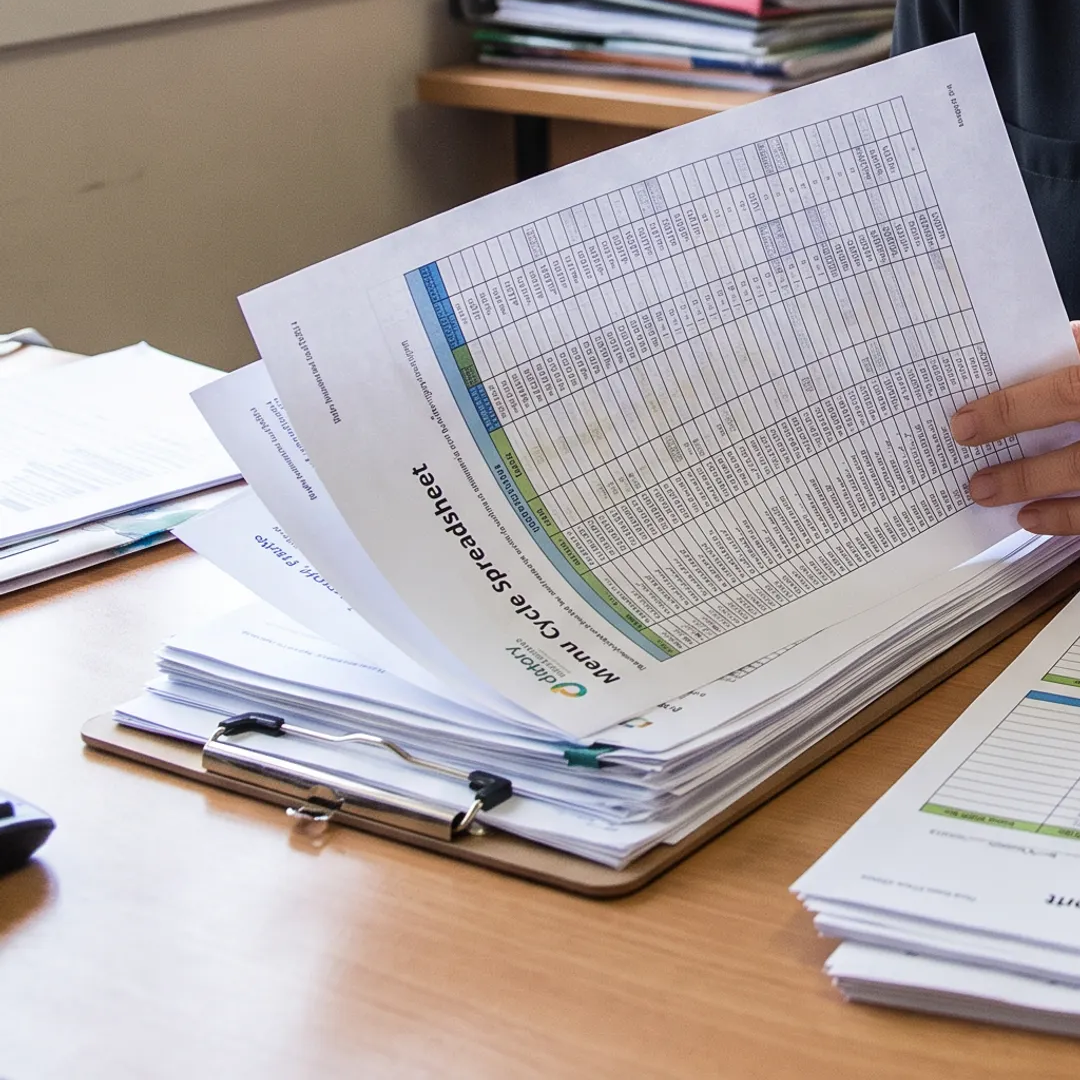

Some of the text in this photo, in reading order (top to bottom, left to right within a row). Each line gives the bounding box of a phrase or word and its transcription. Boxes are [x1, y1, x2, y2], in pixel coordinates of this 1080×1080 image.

[412, 462, 513, 593] Spreadsheet
[509, 593, 561, 640] Cycle
[560, 639, 621, 685] Menu
